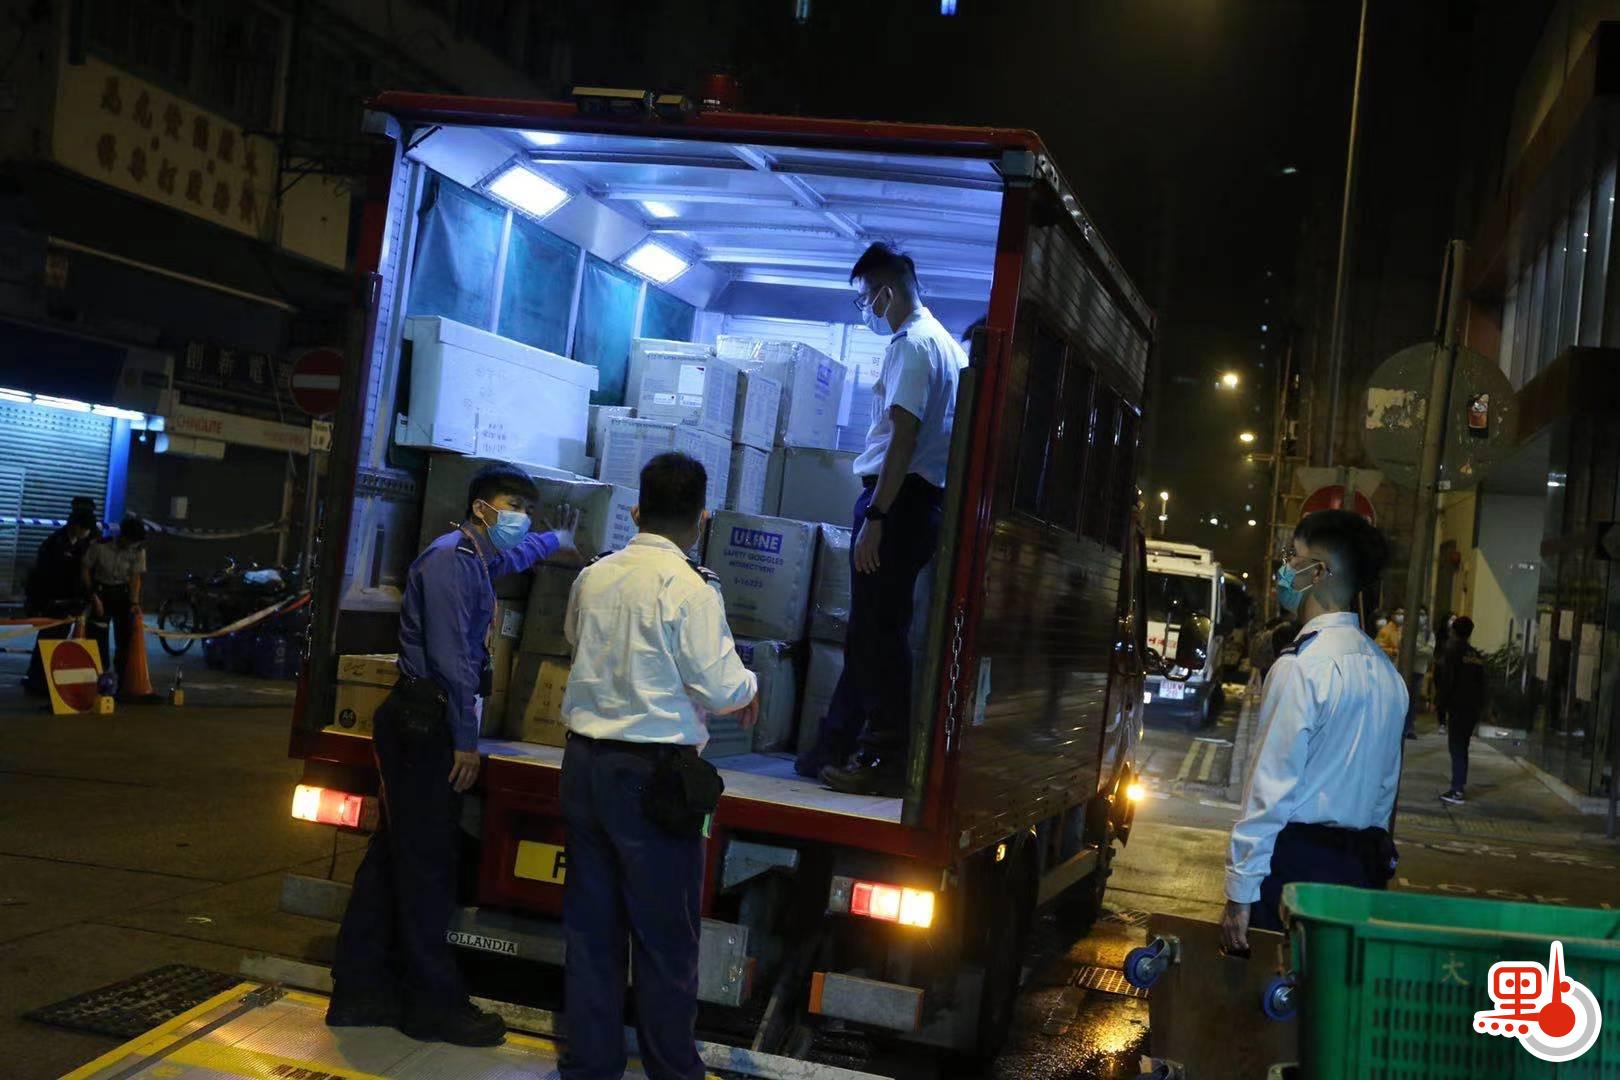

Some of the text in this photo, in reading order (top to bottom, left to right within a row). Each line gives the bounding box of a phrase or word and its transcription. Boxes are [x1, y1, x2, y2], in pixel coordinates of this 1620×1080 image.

[723, 549, 784, 566] SAFETY GOGGLES
[446, 930, 516, 954] OLLANDIA
